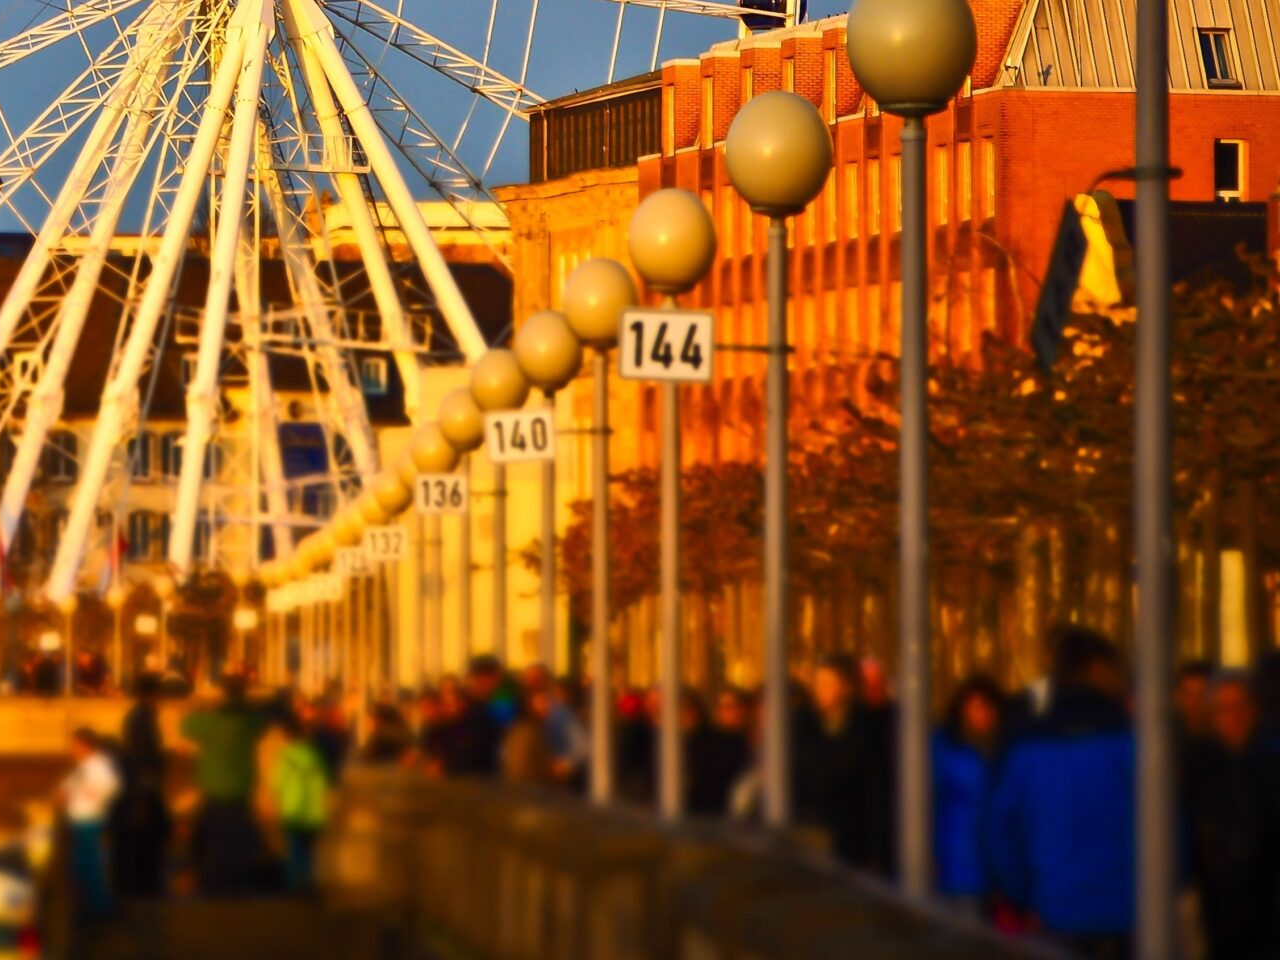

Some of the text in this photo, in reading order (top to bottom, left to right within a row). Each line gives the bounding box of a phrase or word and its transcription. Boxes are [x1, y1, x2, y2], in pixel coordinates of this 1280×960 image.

[630, 321, 703, 371] 144
[494, 417, 548, 454] 140
[422, 480, 462, 508] 136
[370, 532, 402, 555] 132
